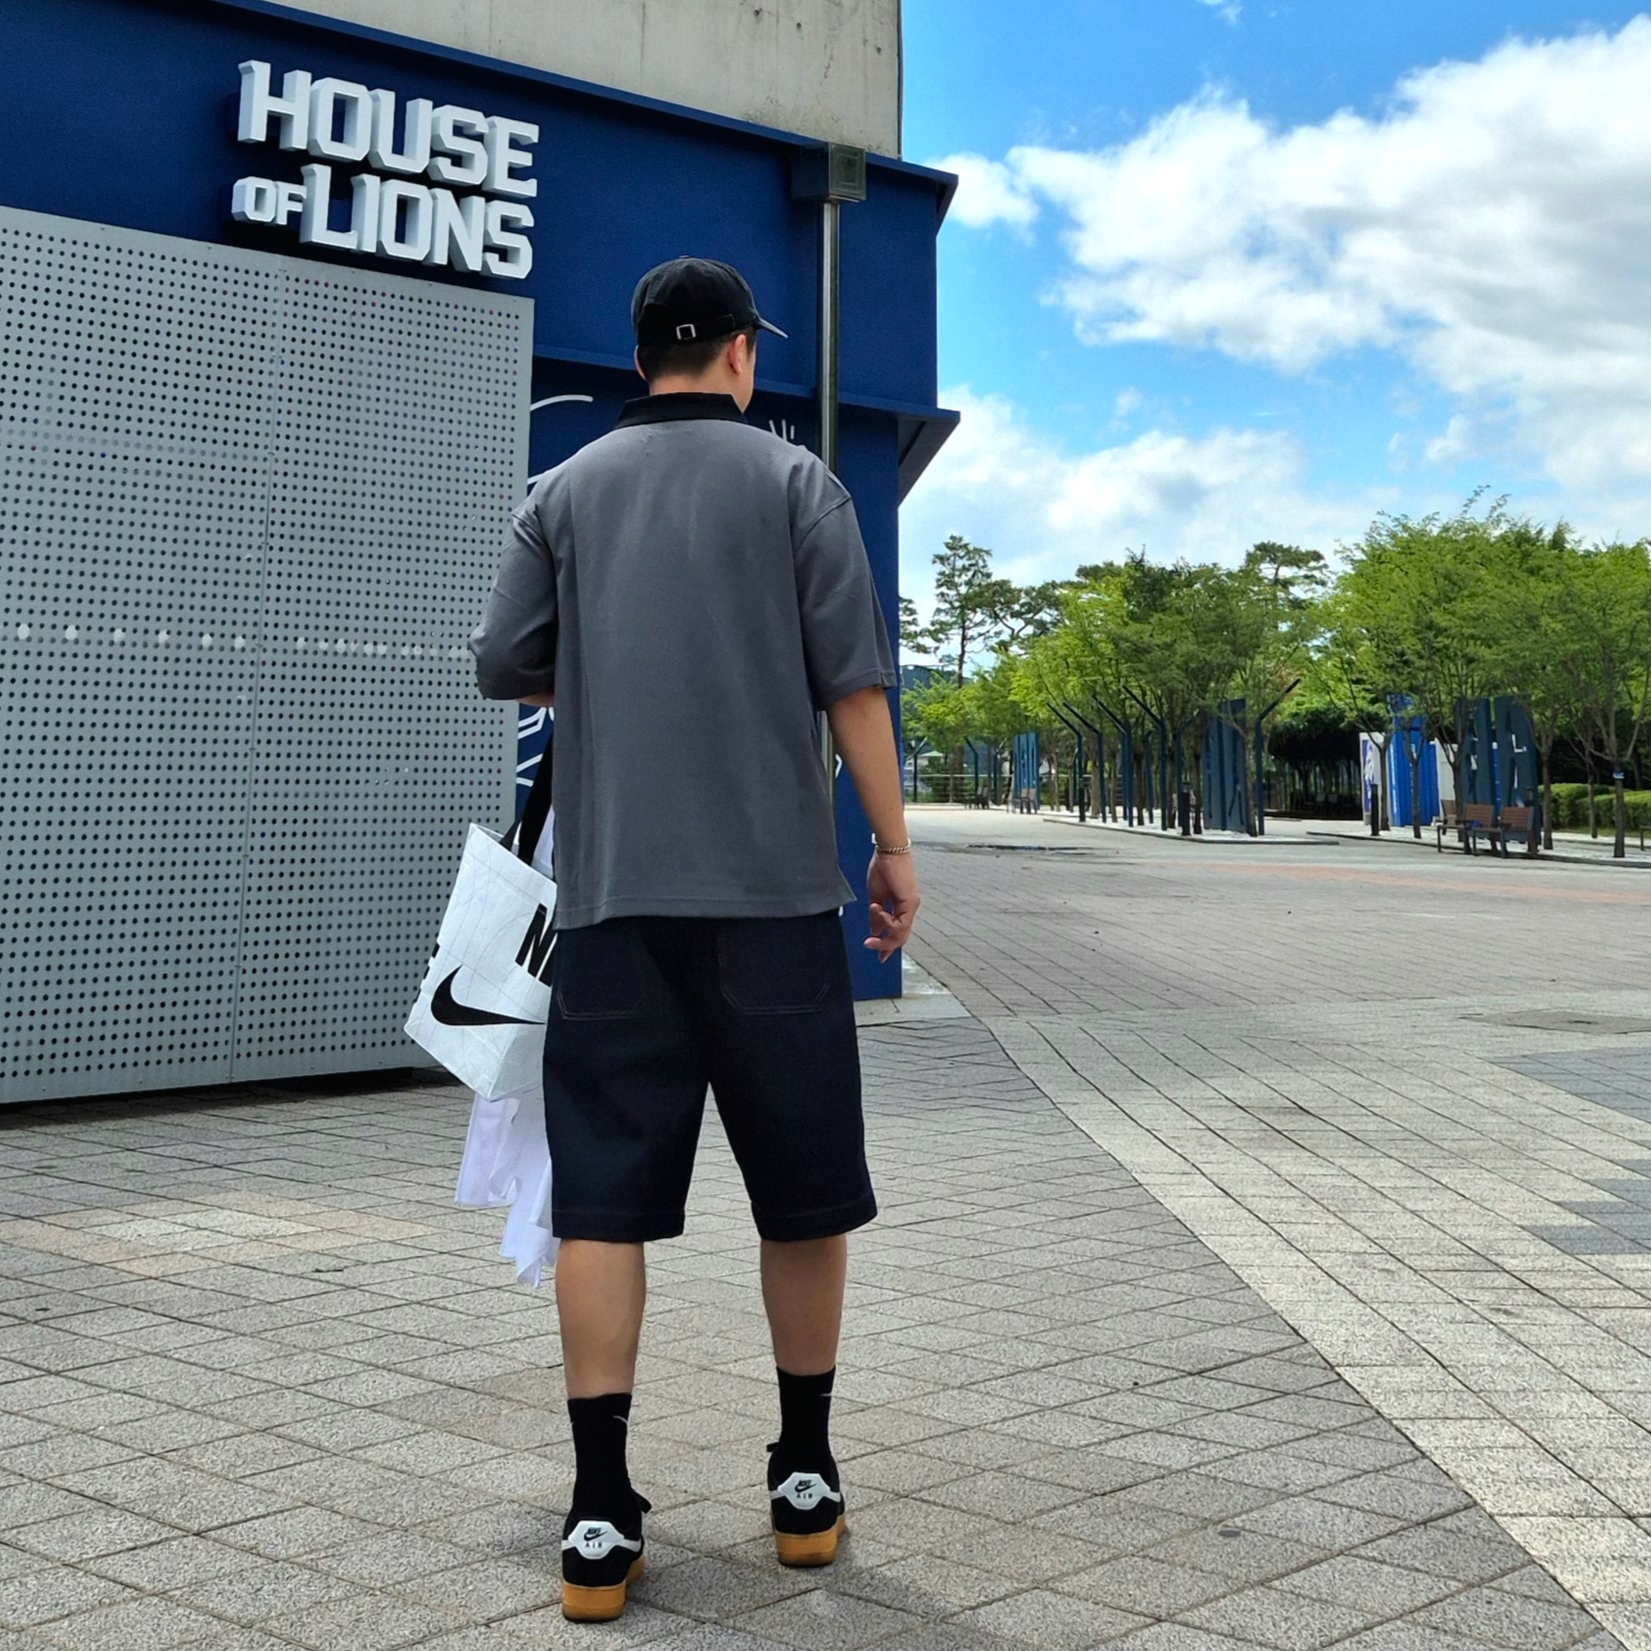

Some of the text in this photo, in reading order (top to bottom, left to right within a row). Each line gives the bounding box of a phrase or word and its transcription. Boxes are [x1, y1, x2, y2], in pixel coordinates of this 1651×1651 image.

[237, 60, 540, 197] HOUSE
[231, 163, 535, 279] OF LIONS
